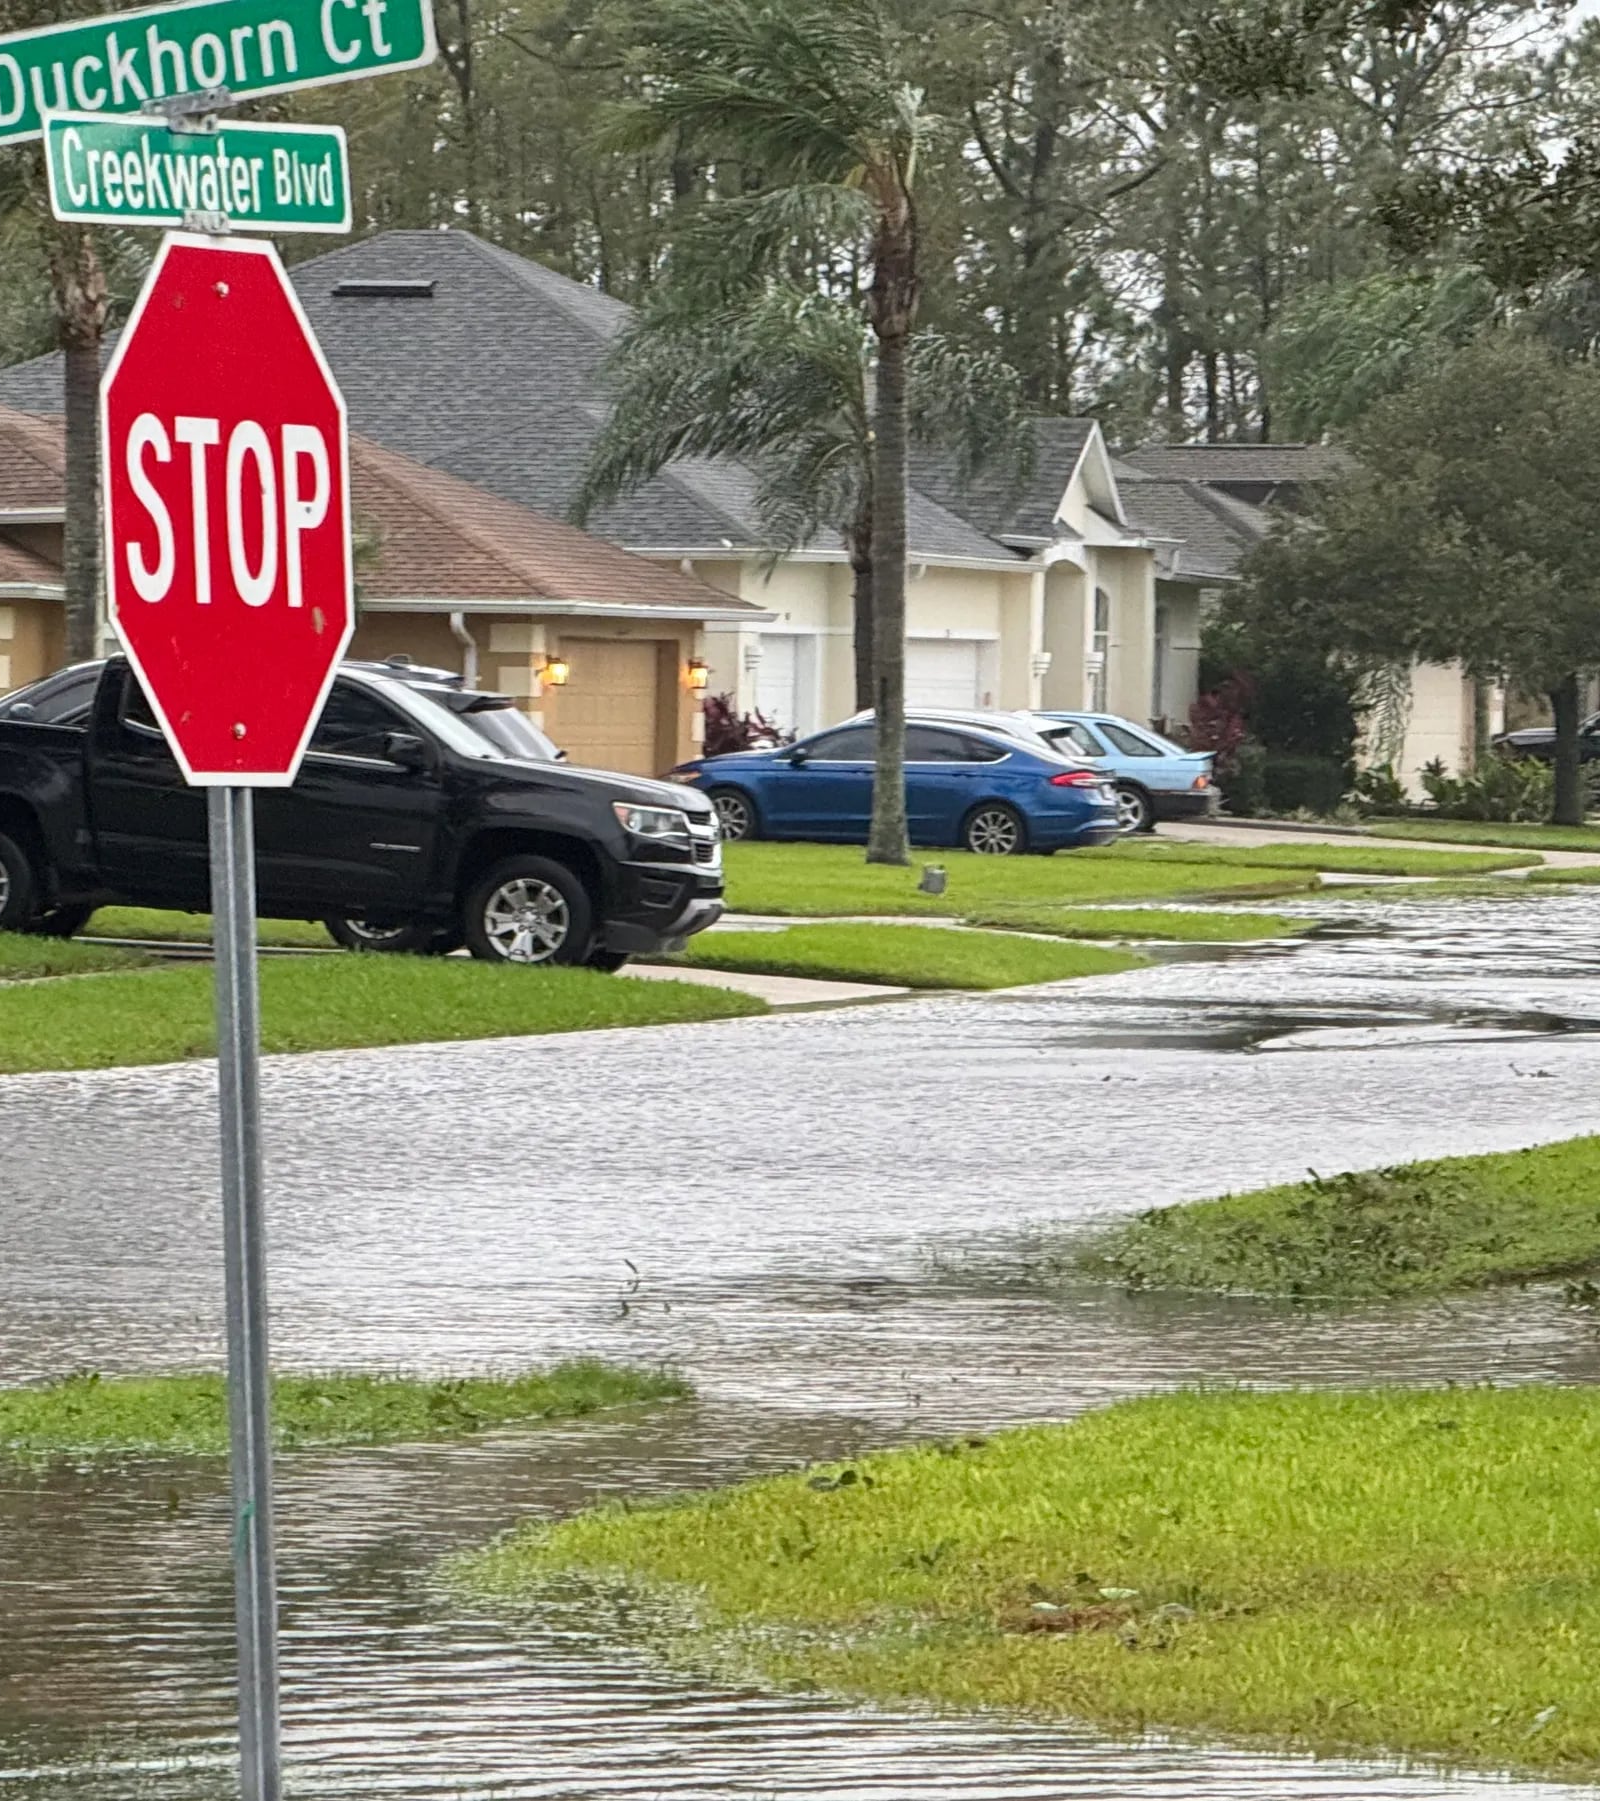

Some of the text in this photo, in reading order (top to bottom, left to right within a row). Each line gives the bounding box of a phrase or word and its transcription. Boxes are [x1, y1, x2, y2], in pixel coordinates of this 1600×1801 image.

[321, 0, 392, 64] Ct
[62, 127, 334, 213] Creekwater Blvd
[126, 412, 330, 608] STOP
